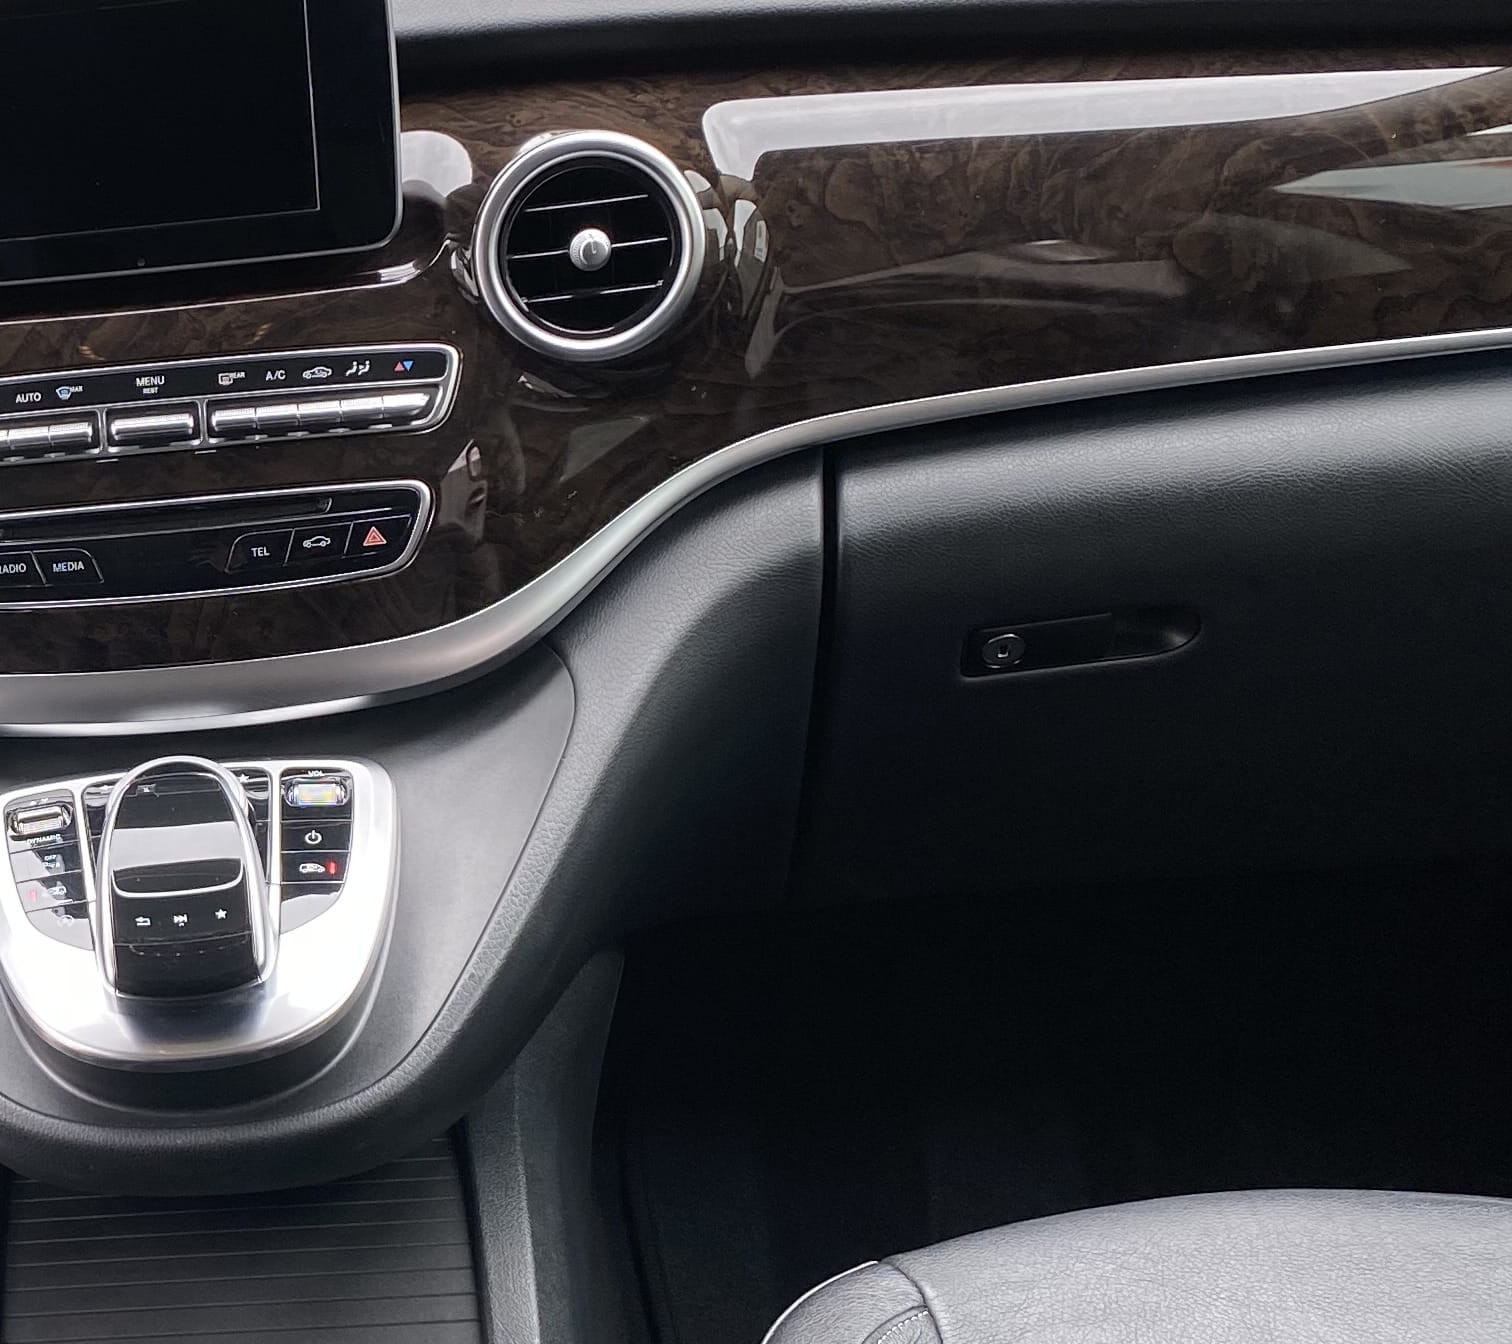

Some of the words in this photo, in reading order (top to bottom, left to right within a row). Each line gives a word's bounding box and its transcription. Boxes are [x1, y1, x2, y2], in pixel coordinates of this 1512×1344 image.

[135, 375, 165, 387] MENU
[265, 369, 287, 381] A/C
[15, 391, 42, 404] AUTO
[250, 546, 271, 558] TEL
[52, 561, 85, 573] MEDIA
[26, 833, 62, 845] DYNAMIC
